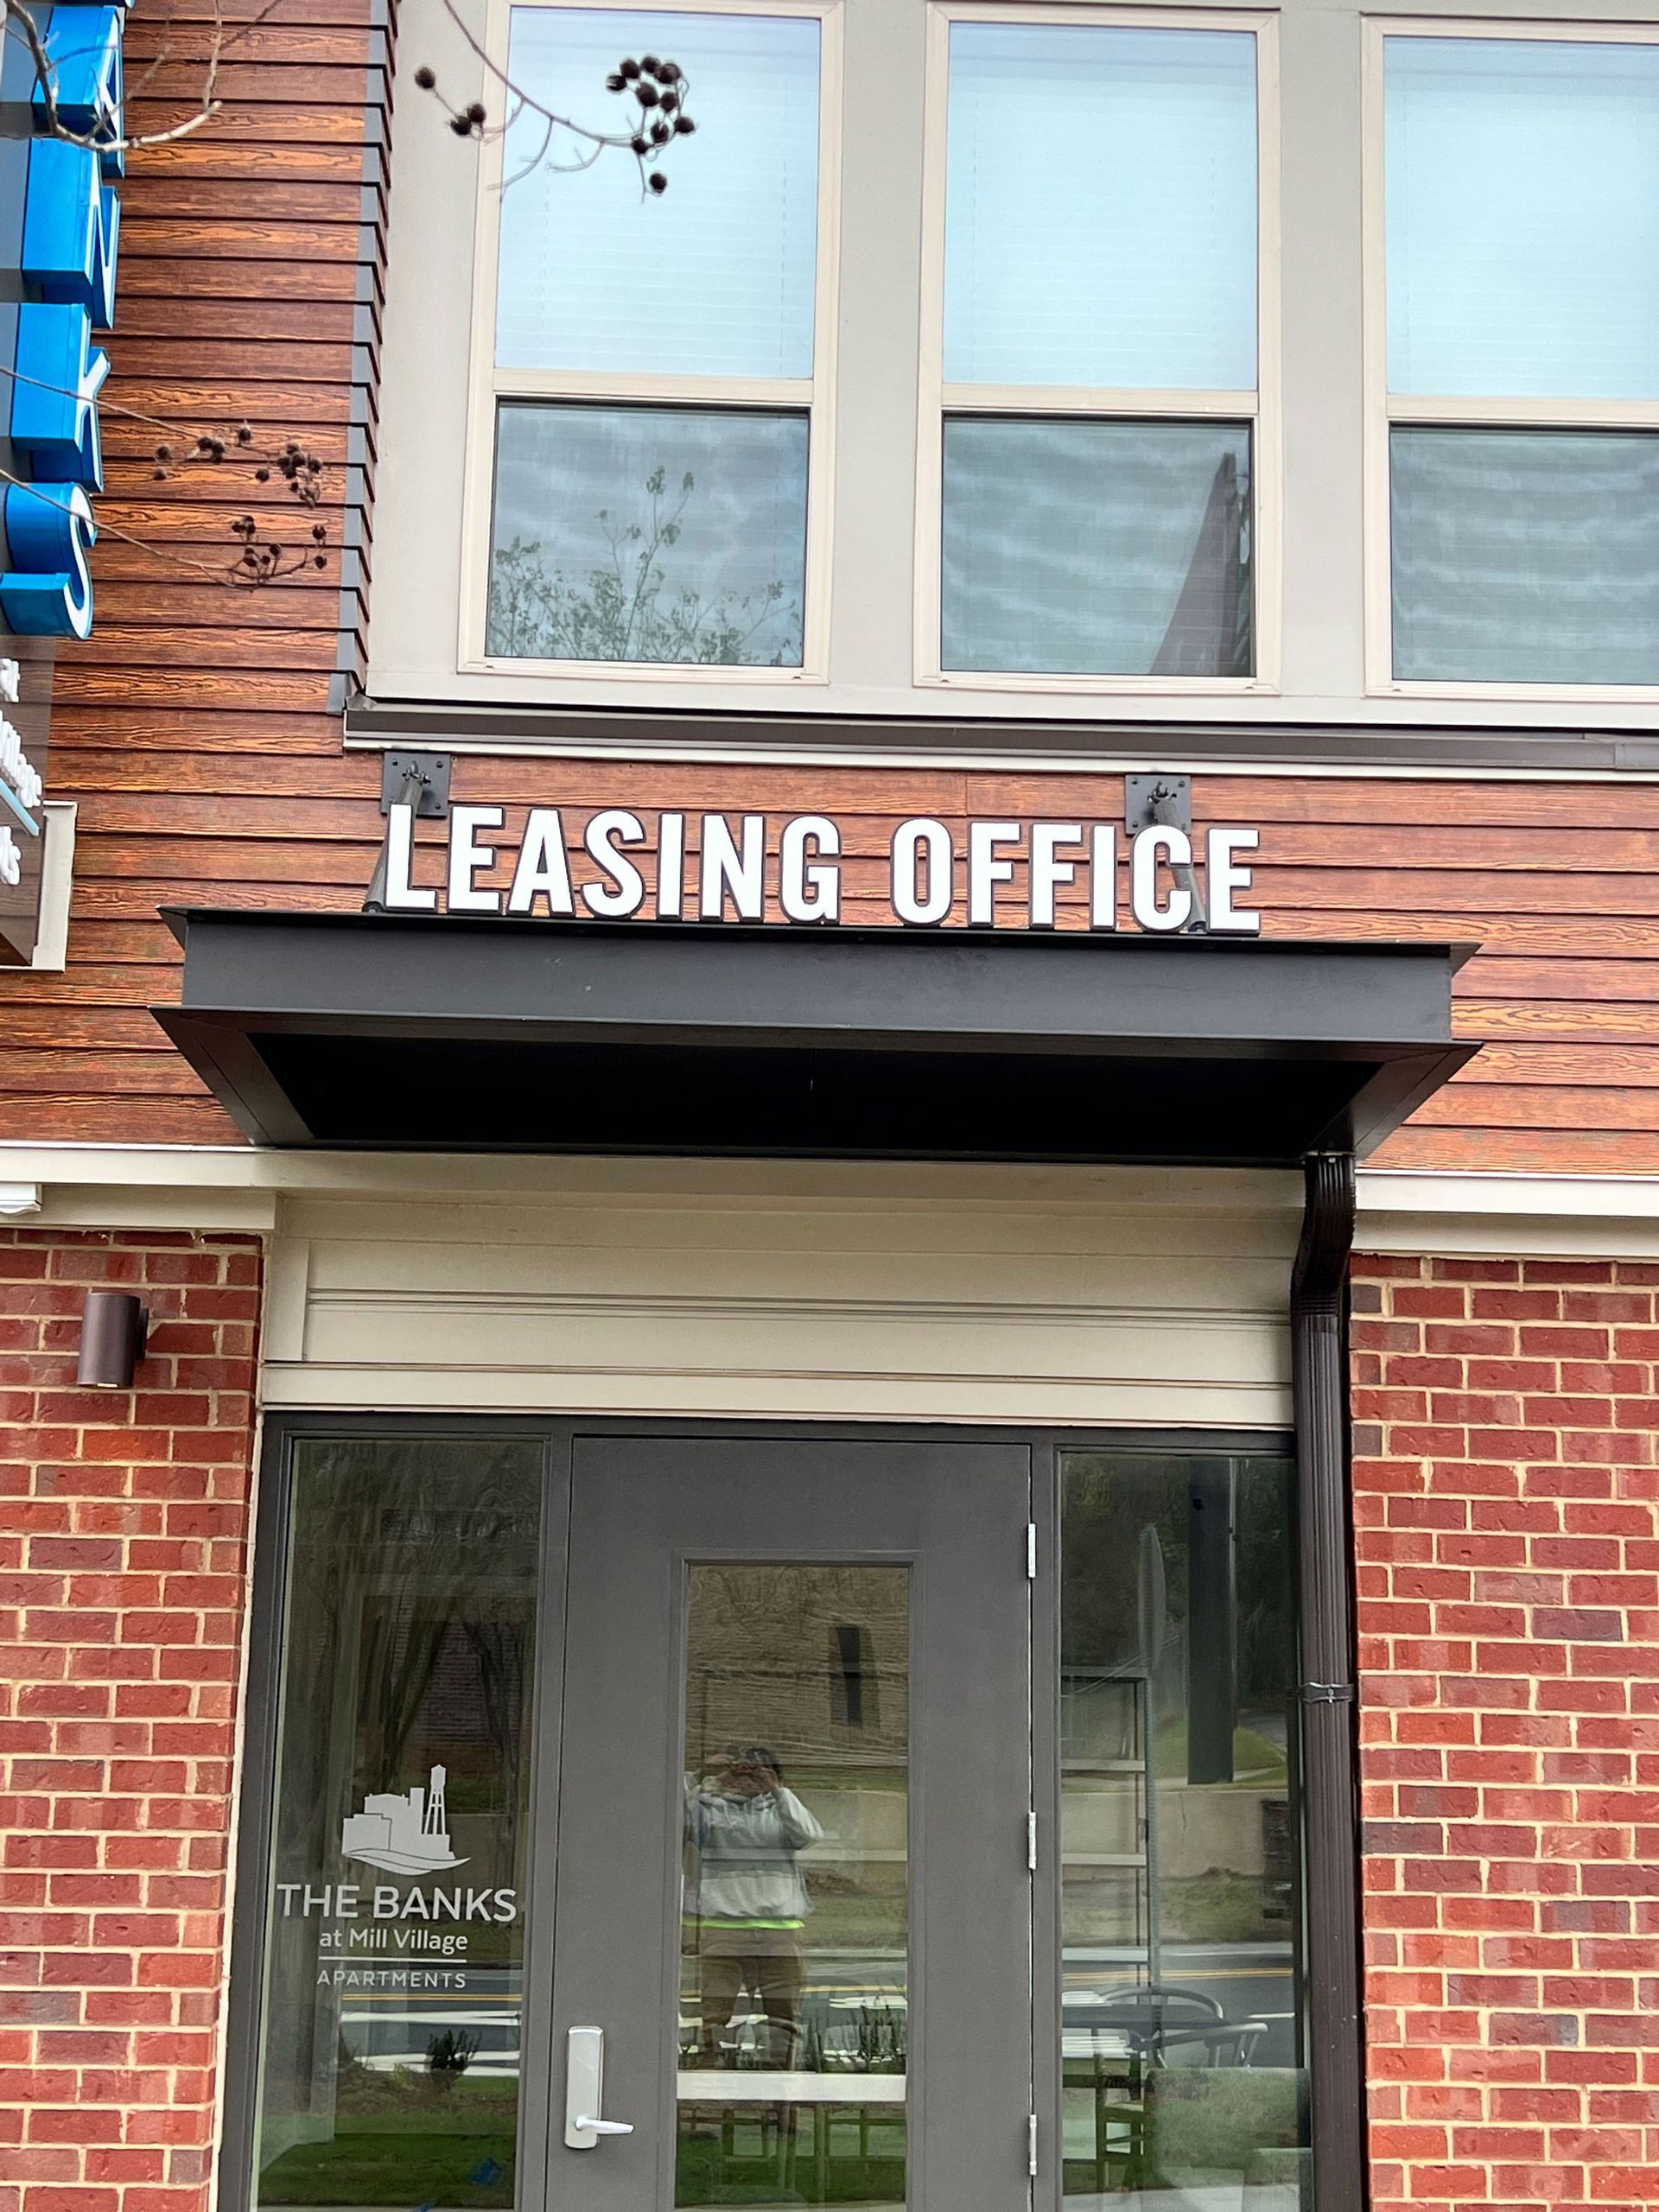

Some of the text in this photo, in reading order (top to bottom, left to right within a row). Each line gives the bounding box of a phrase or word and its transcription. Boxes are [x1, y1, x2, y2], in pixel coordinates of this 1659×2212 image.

[7, 0, 133, 639] ANKS
[385, 802, 1261, 935] LEASING OFFICE
[276, 1884, 518, 1923] THE BANKS
[319, 1928, 468, 1955] at Mill Village
[316, 1969, 467, 1988] APARTMENTS
